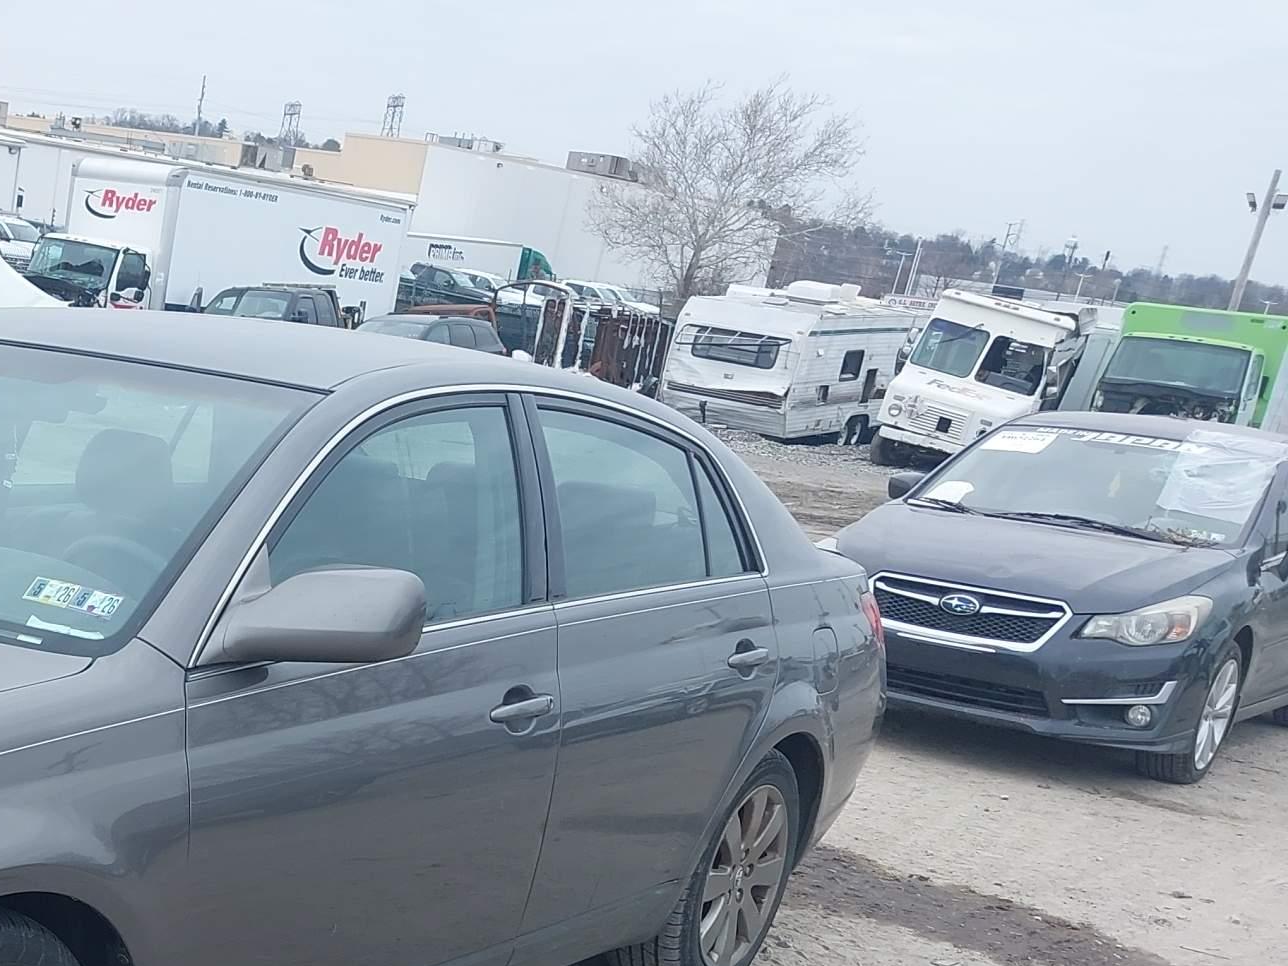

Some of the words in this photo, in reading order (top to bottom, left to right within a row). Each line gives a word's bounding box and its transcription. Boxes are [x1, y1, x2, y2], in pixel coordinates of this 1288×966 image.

[100, 189, 157, 213] Ryder
[318, 226, 383, 266] Ryder
[339, 263, 359, 279] Ever
[33, 583, 45, 597] 5
[57, 586, 75, 603] 26
[77, 592, 89, 607] 5
[102, 597, 120, 615] 26
